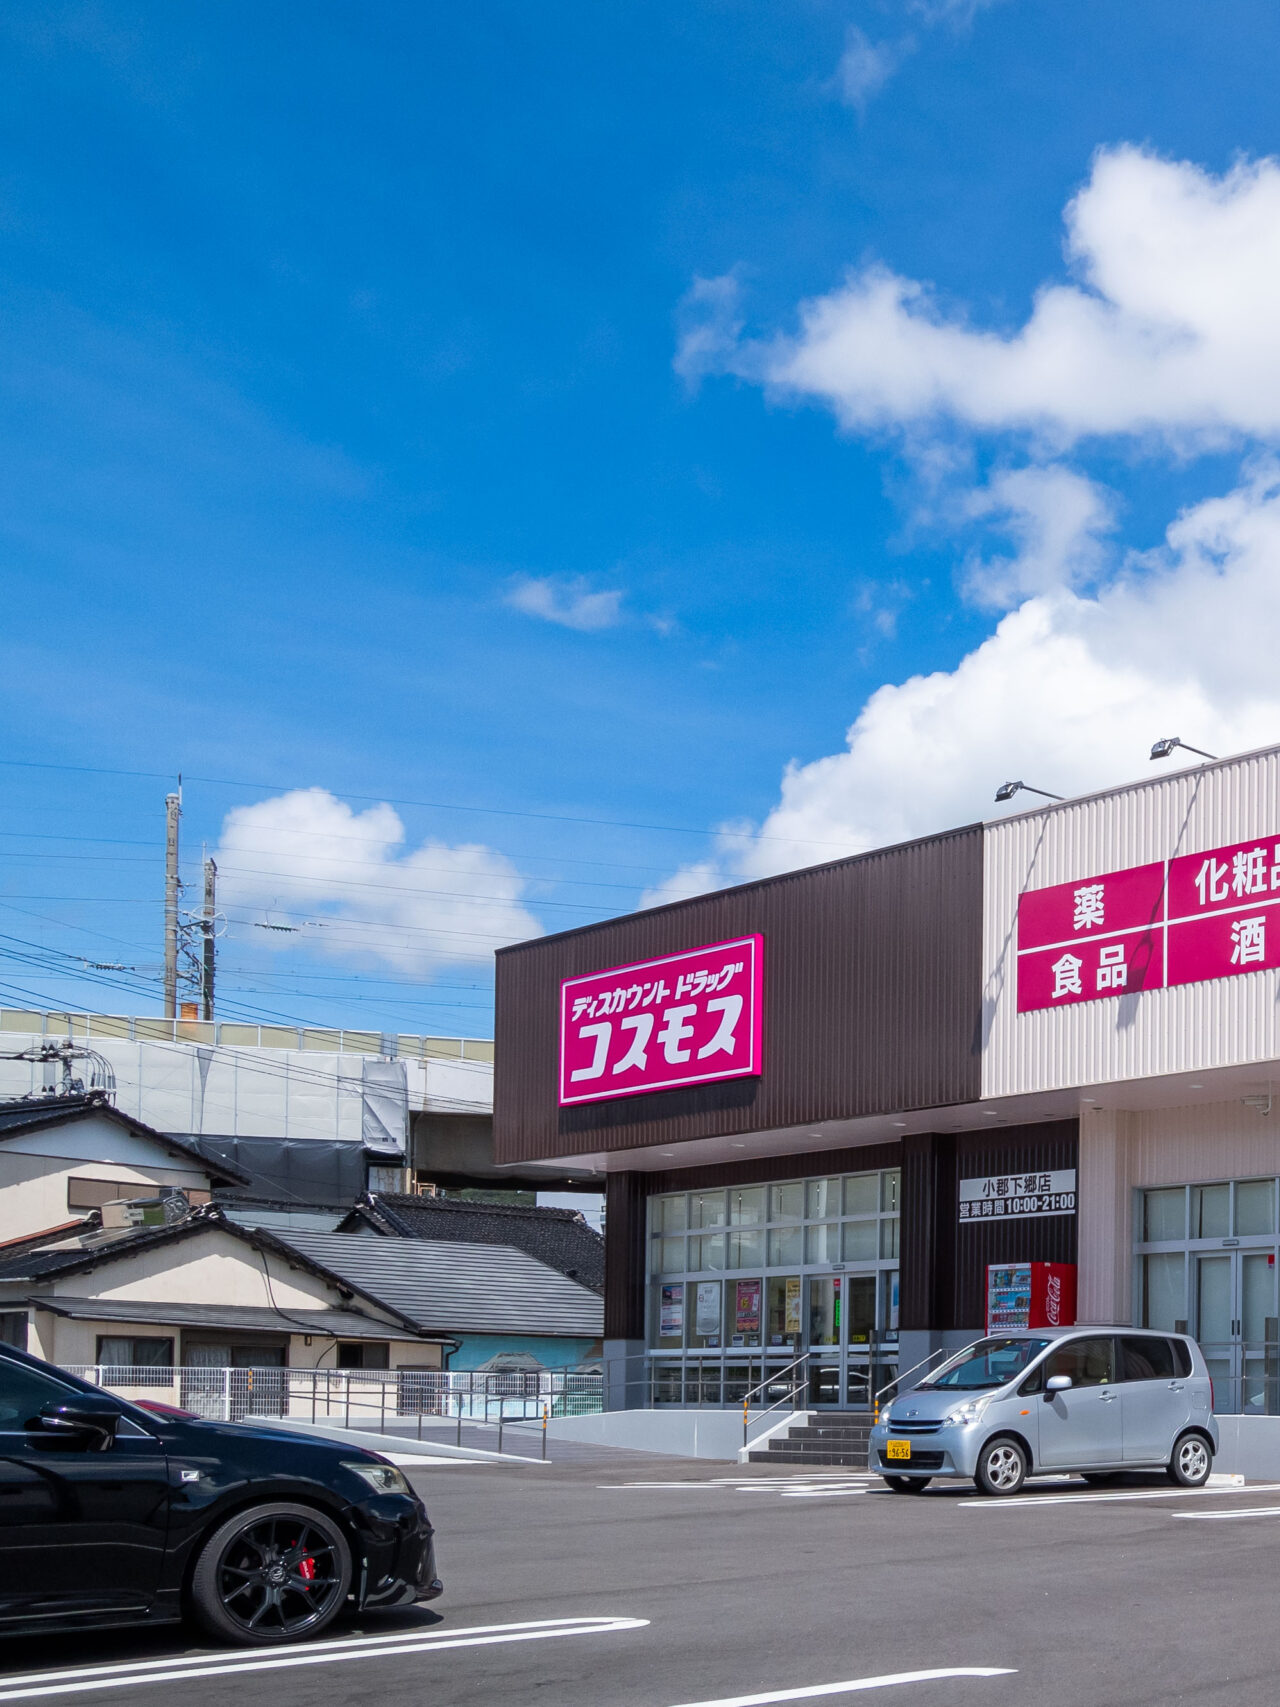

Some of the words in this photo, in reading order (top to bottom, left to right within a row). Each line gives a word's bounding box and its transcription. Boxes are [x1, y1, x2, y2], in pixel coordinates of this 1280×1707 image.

[1073, 884, 1104, 930] 薬
[1230, 916, 1266, 965] 酒
[572, 980, 670, 1022] ディスカウント
[675, 962, 743, 1000] ドラッグ
[1051, 944, 1127, 999] 食品
[571, 994, 743, 1082] コスモス
[960, 1200, 1004, 1217] 営業時間
[983, 1174, 1051, 1197] 小郡下郷店
